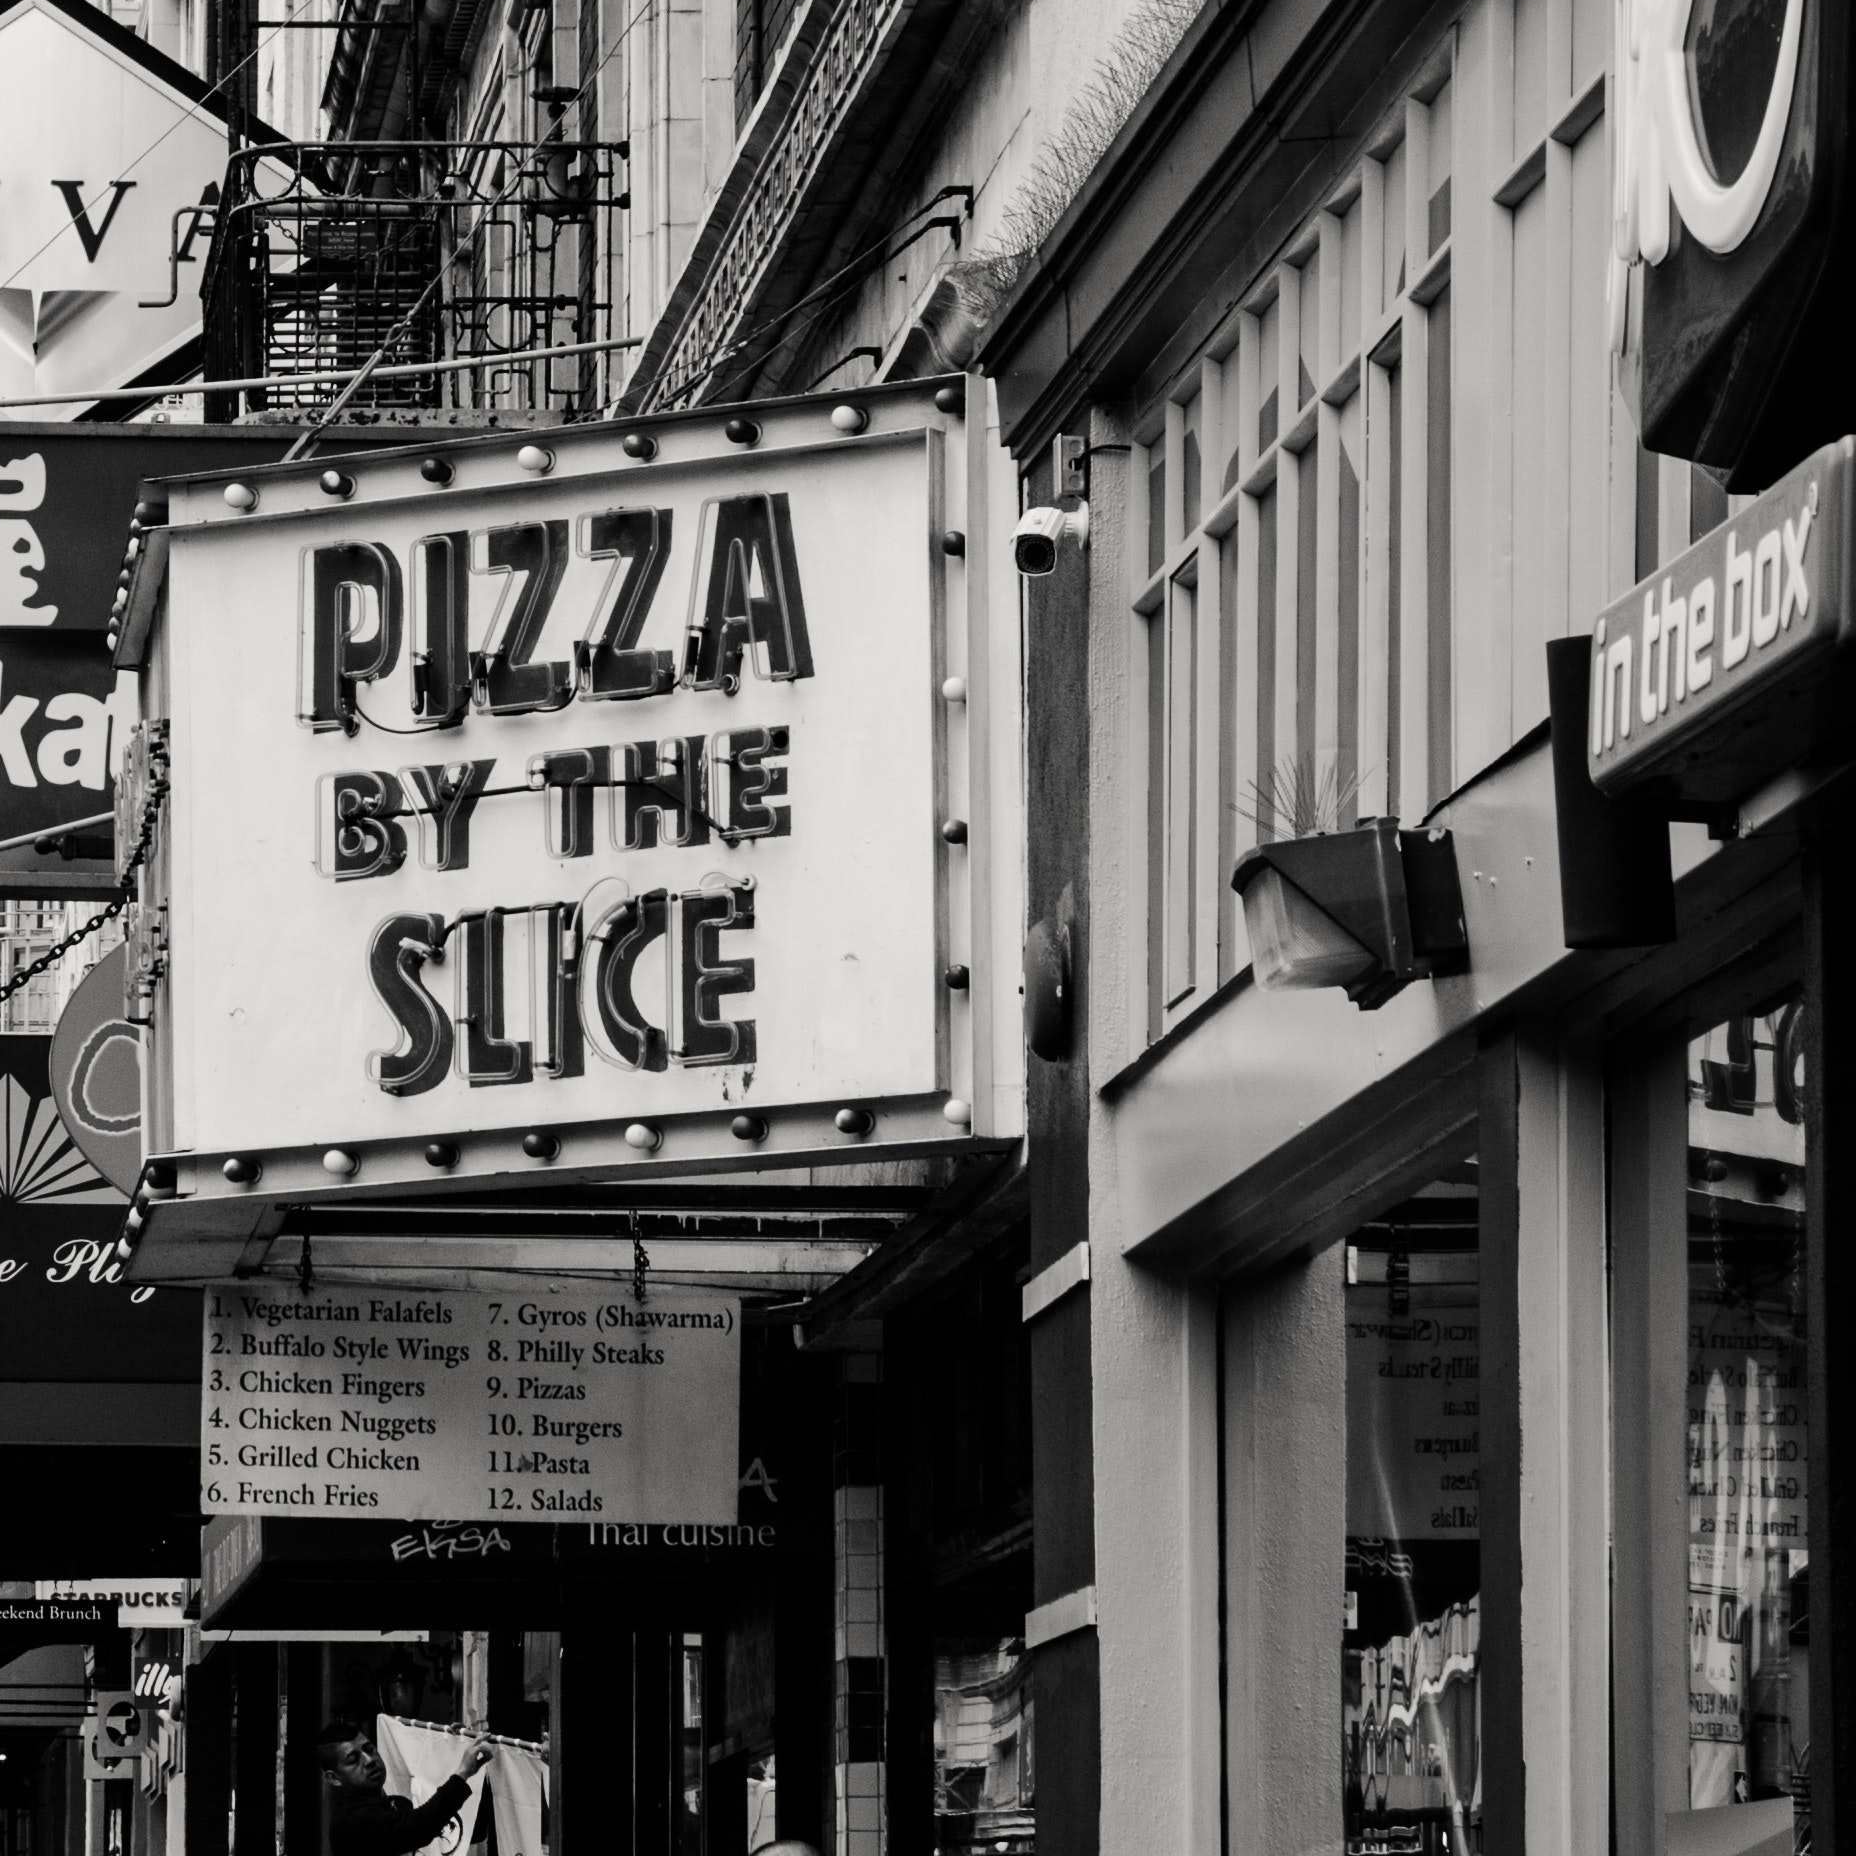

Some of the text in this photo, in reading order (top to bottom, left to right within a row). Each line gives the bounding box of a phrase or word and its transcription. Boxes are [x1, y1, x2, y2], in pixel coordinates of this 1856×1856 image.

[301, 492, 815, 734] PIZZA
[1591, 506, 1812, 758] in the box
[318, 726, 792, 882] BY THE
[367, 887, 756, 1097] SLICE
[211, 1296, 453, 1327] 1. Vegetarian Falafels
[488, 1303, 734, 1336] 7. Gyros (Shawarma)
[210, 1333, 470, 1368] 2. Buffalo Style Wings
[488, 1340, 664, 1370] 8. Philly Steaks
[209, 1370, 425, 1404] 3. Chicken Fingers
[487, 1376, 586, 1400] 9. Pizzas
[208, 1407, 437, 1441] 4. Chicken Nuggets
[487, 1414, 623, 1445] 10. Burgers
[208, 1444, 420, 1471] 5. Grilled Chicken
[532, 1452, 590, 1475] Pasta
[207, 1481, 379, 1507] 6. French Fries
[487, 1488, 603, 1512] 12. Salads
[50, 1605, 101, 1621] Brunch
